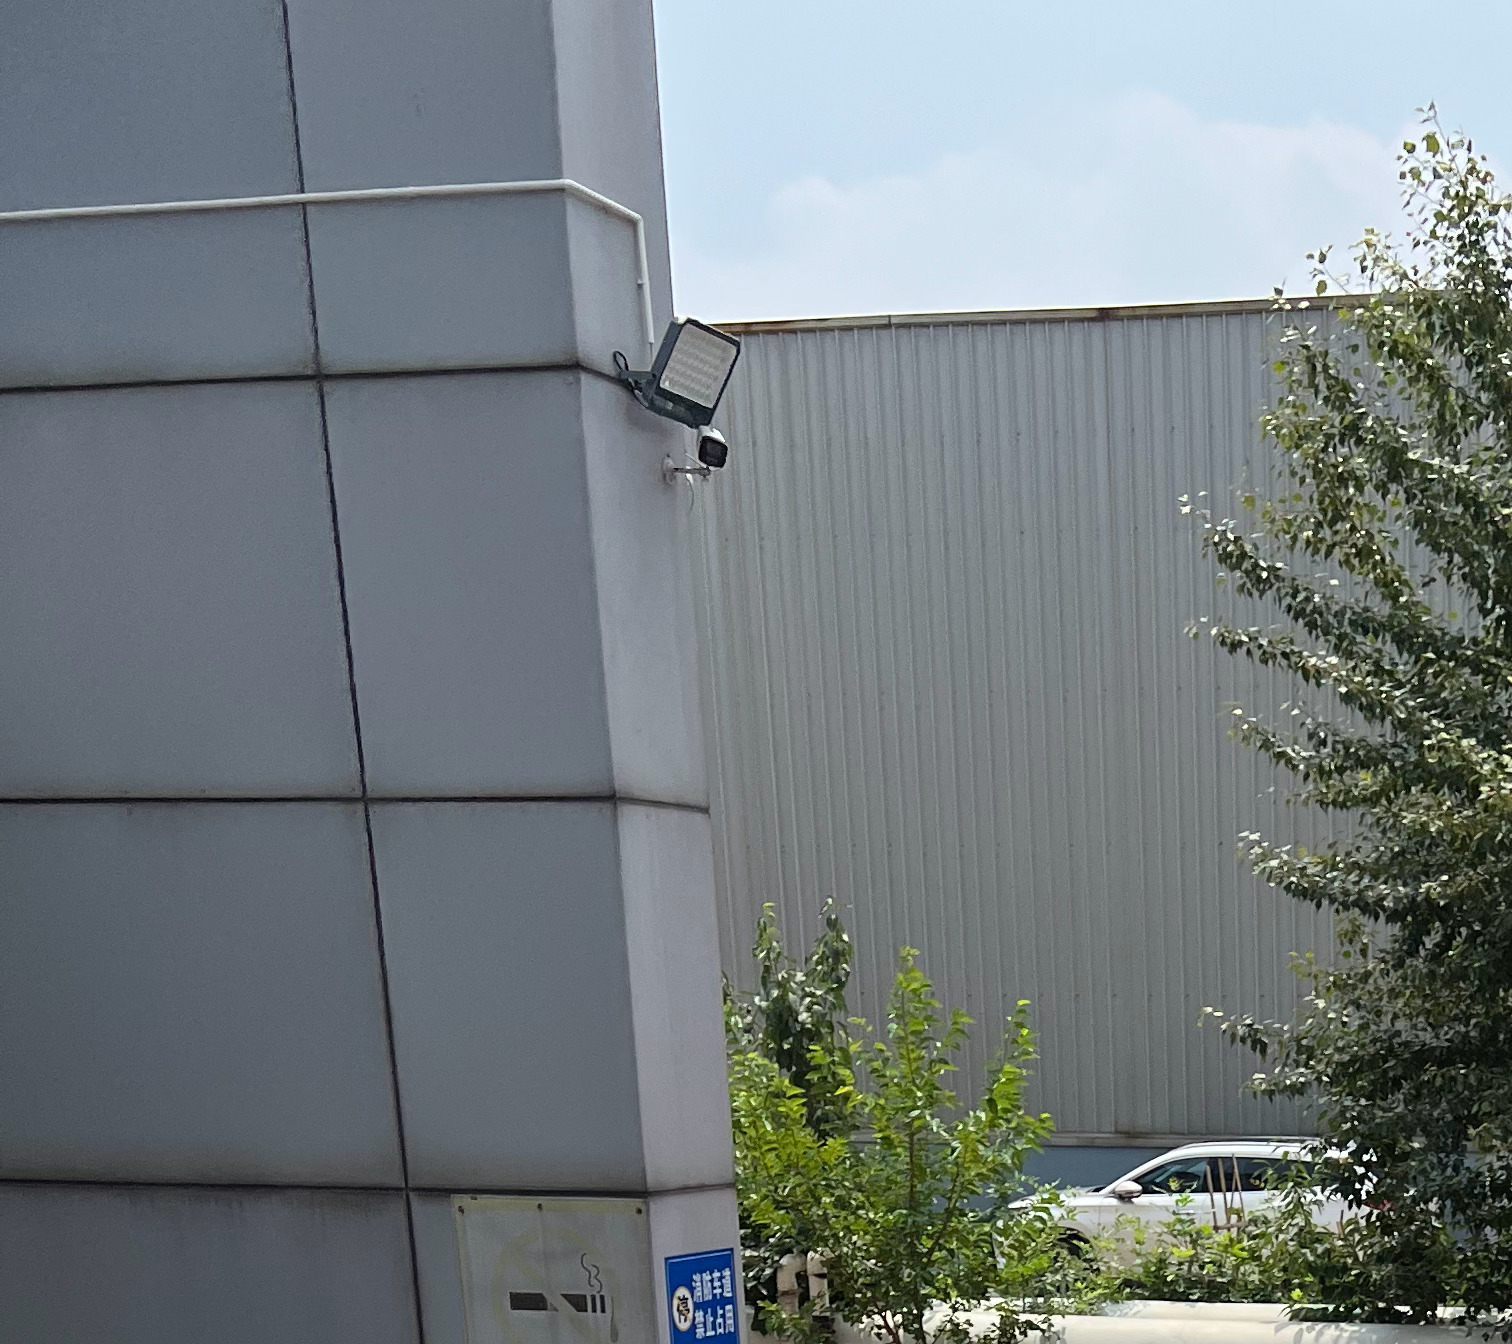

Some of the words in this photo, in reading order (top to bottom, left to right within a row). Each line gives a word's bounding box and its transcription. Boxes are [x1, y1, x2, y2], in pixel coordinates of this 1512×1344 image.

[691, 1267, 733, 1303] 消防车道
[694, 1304, 735, 1340] 禁止占用
